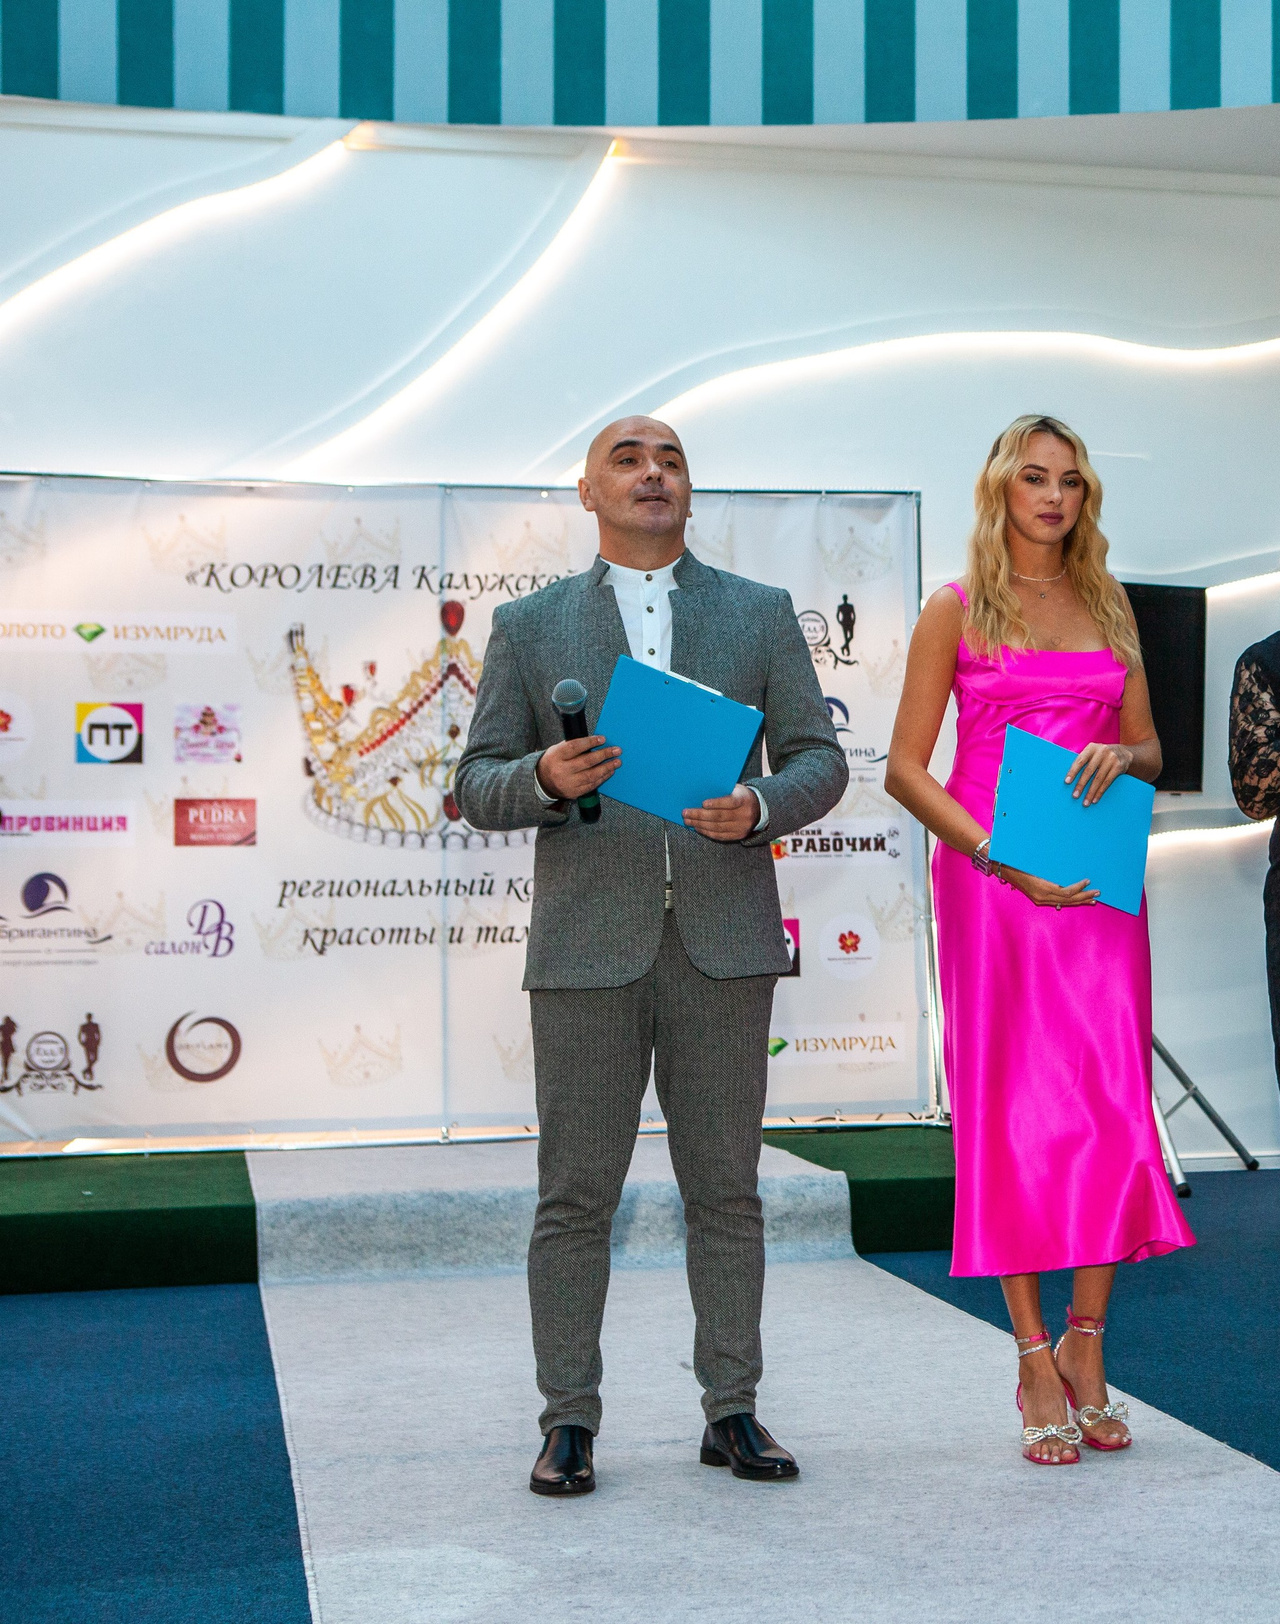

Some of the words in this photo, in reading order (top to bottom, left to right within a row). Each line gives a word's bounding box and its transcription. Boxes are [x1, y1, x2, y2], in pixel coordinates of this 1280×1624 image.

[186, 562, 401, 594] «КОРОЛЕВА
[412, 564, 578, 600] Калужско
[113, 624, 227, 643] ИЗУМРУДА
[88, 723, 133, 746] ПТ
[188, 806, 247, 824] PUDRA
[791, 832, 887, 853] РАБОЧИЙ
[277, 872, 495, 908] региональный
[144, 940, 202, 955] салон
[302, 925, 435, 956] красоты
[449, 926, 464, 945] и
[795, 1035, 897, 1053] ИЗУМРУДА
